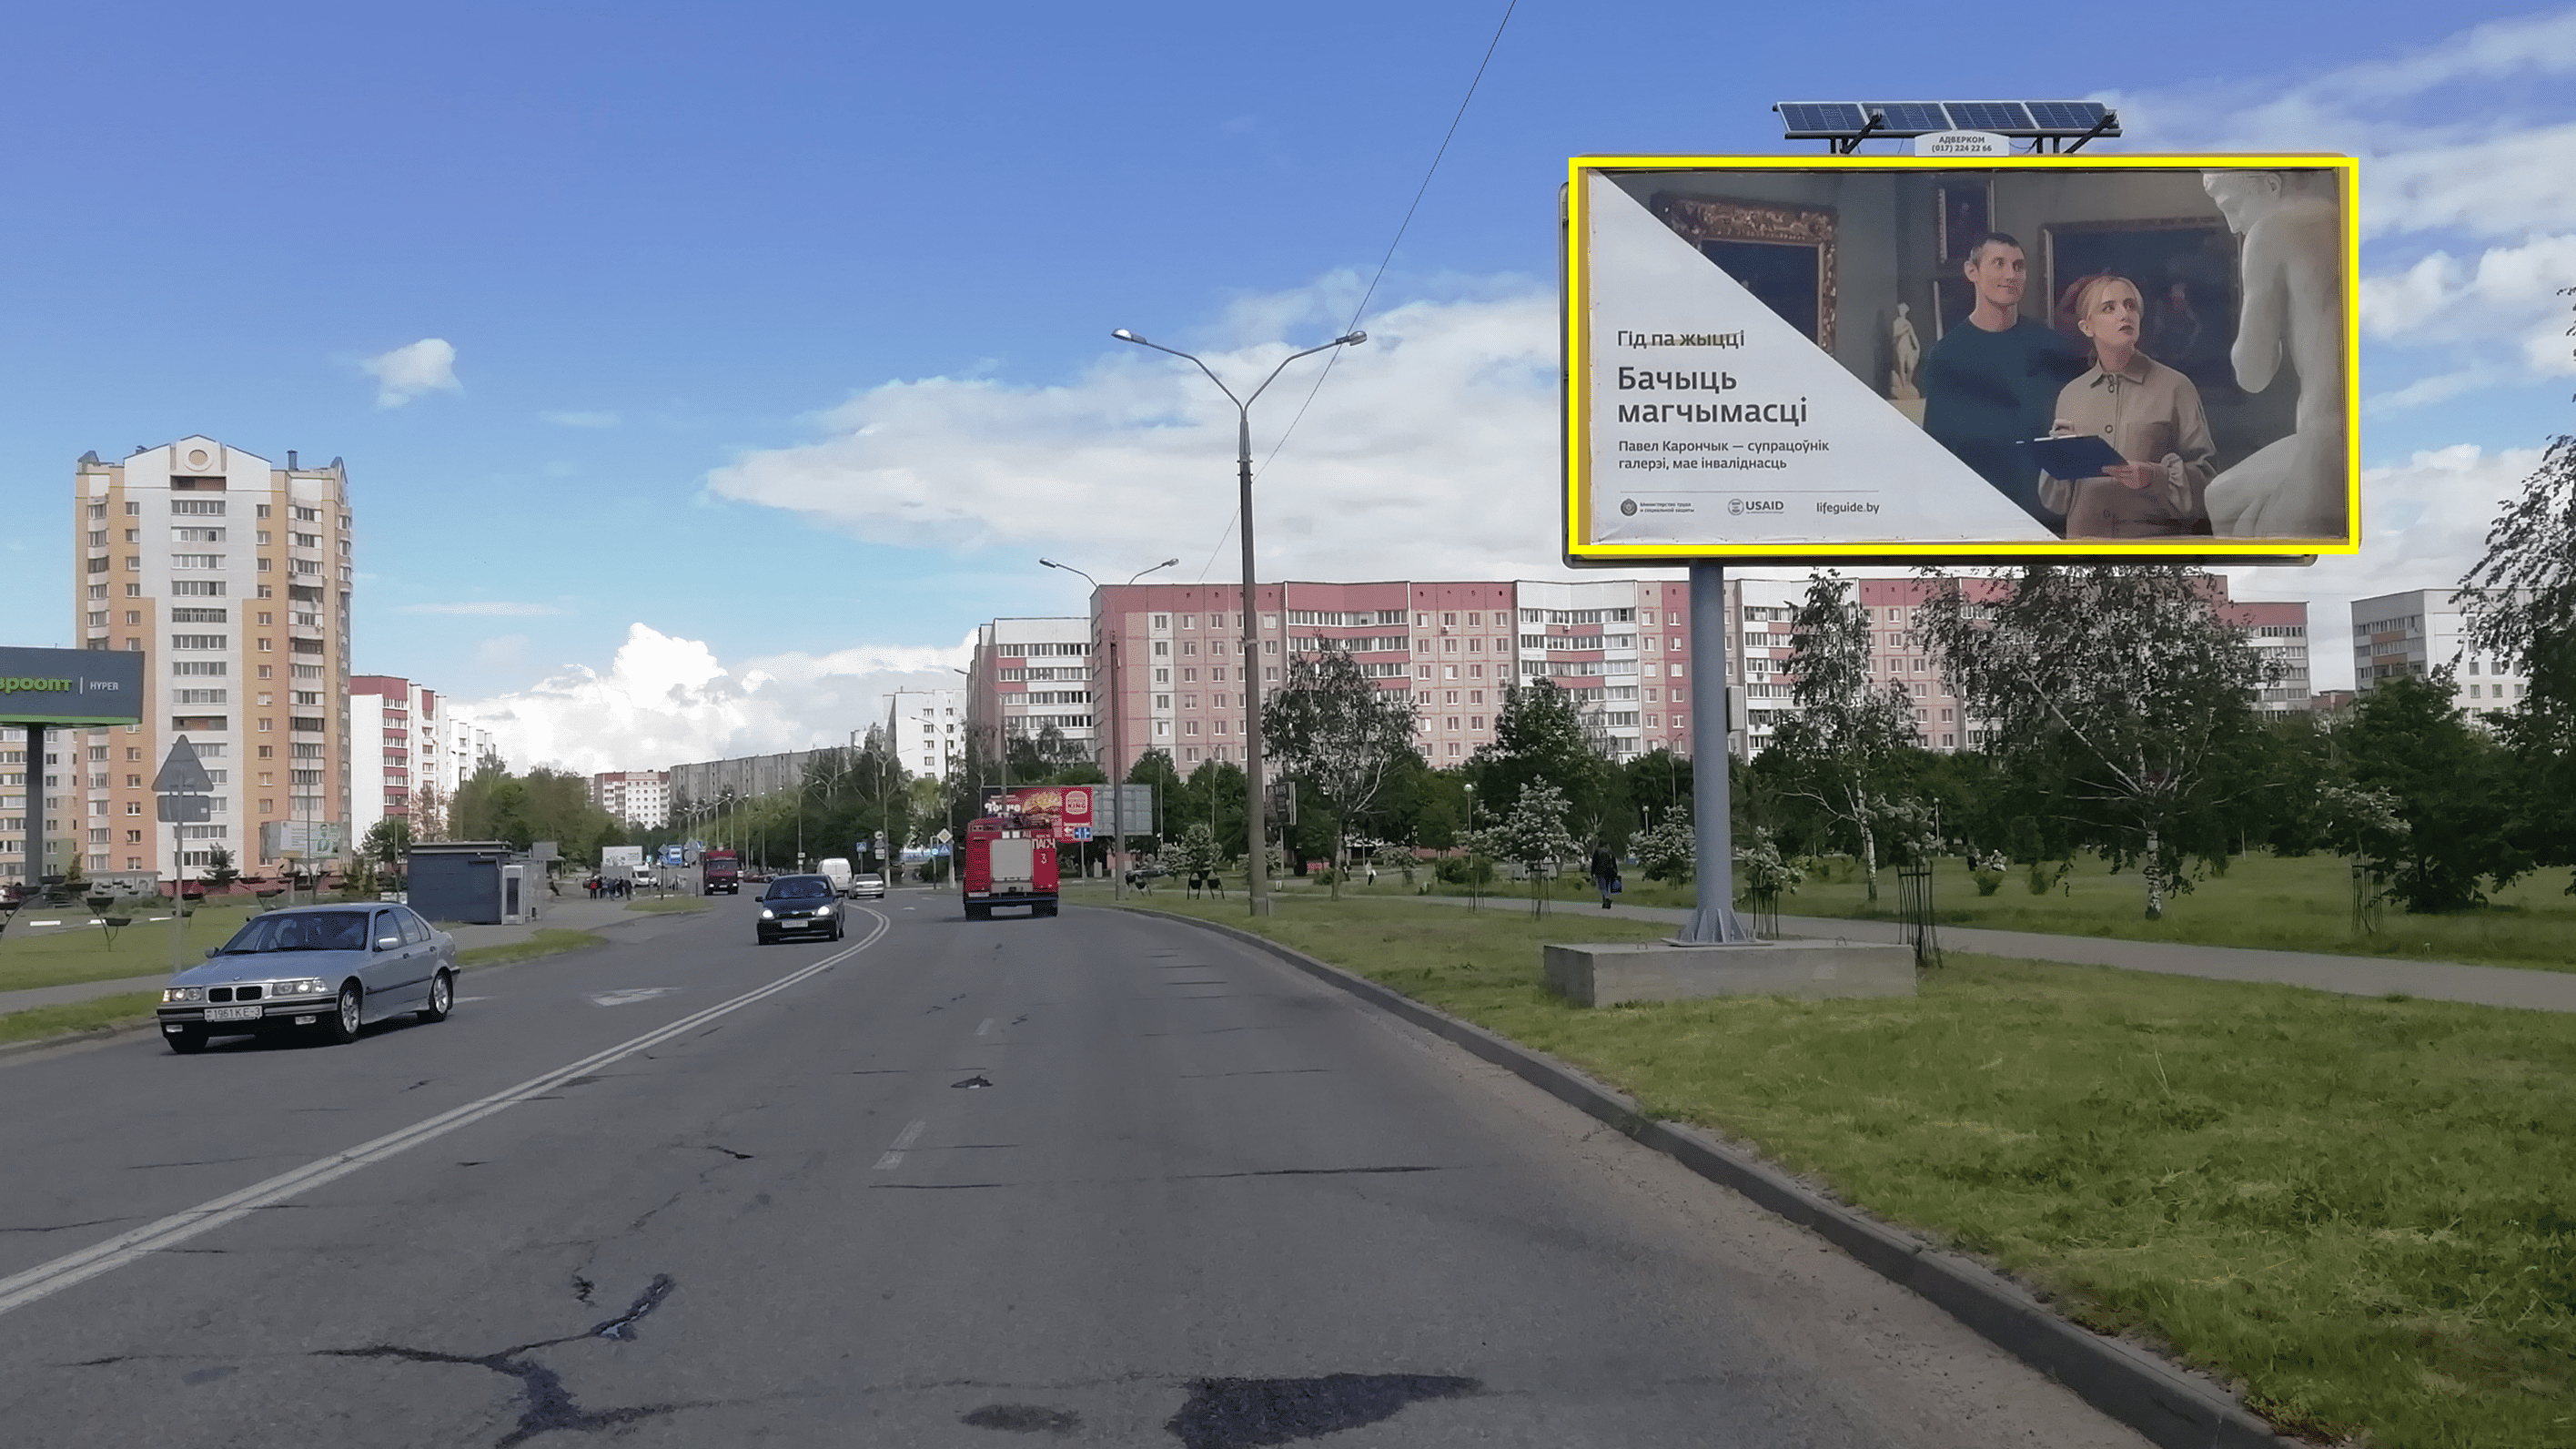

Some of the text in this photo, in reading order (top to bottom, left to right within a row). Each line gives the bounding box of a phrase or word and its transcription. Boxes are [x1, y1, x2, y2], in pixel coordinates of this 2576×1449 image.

[1932, 144, 1954, 152] (017)
[1618, 329, 1744, 350] Гід па жыцці
[1619, 366, 1737, 394] Бачыць
[1618, 396, 1807, 427] магчымасці
[1618, 440, 1660, 452] Павел
[1662, 440, 1729, 454] Карончык
[1747, 440, 1830, 454] супрацоўнік
[1618, 457, 1787, 471] галерэі, мае інваліднасць
[1745, 501, 1784, 511] USAID
[1816, 502, 1880, 514] lifeguide.by
[90, 681, 119, 691] HYPER
